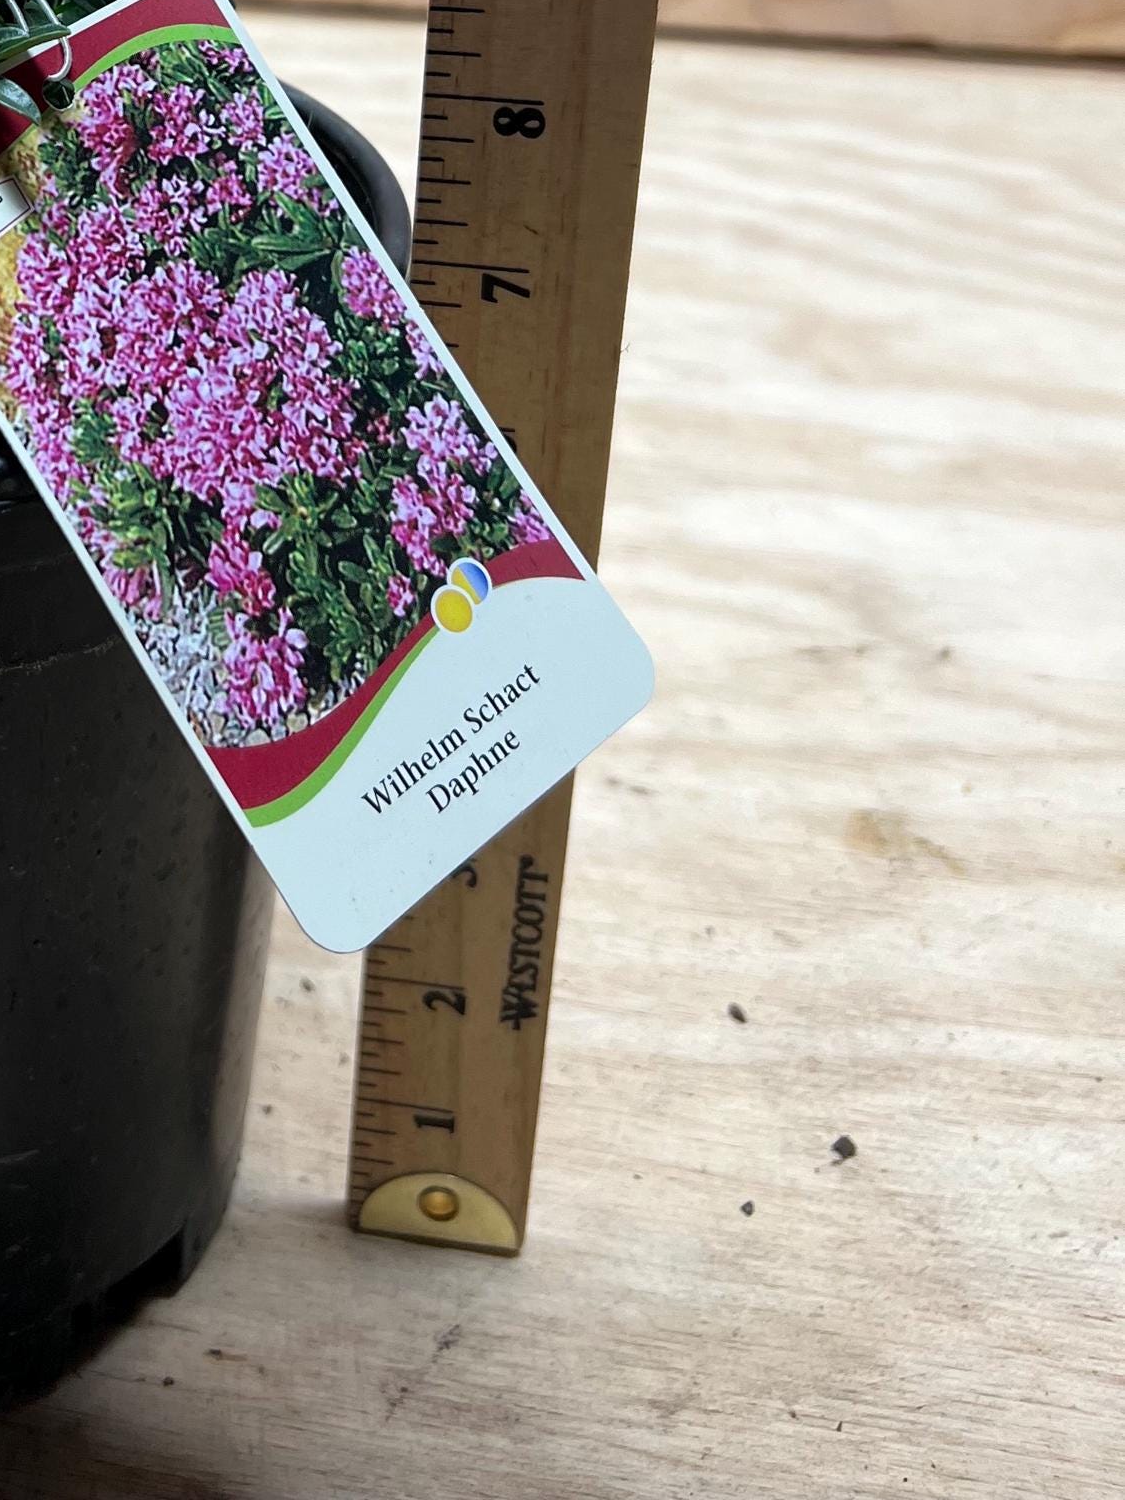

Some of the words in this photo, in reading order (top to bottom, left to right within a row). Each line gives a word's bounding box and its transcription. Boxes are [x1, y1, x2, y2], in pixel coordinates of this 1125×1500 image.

[492, 105, 546, 140] 8
[480, 273, 531, 304] 7
[360, 727, 467, 815] Wilhelm
[462, 663, 541, 734] Schact
[425, 729, 521, 814] Daphne
[422, 990, 467, 1016] 2
[412, 1109, 455, 1135] 1
